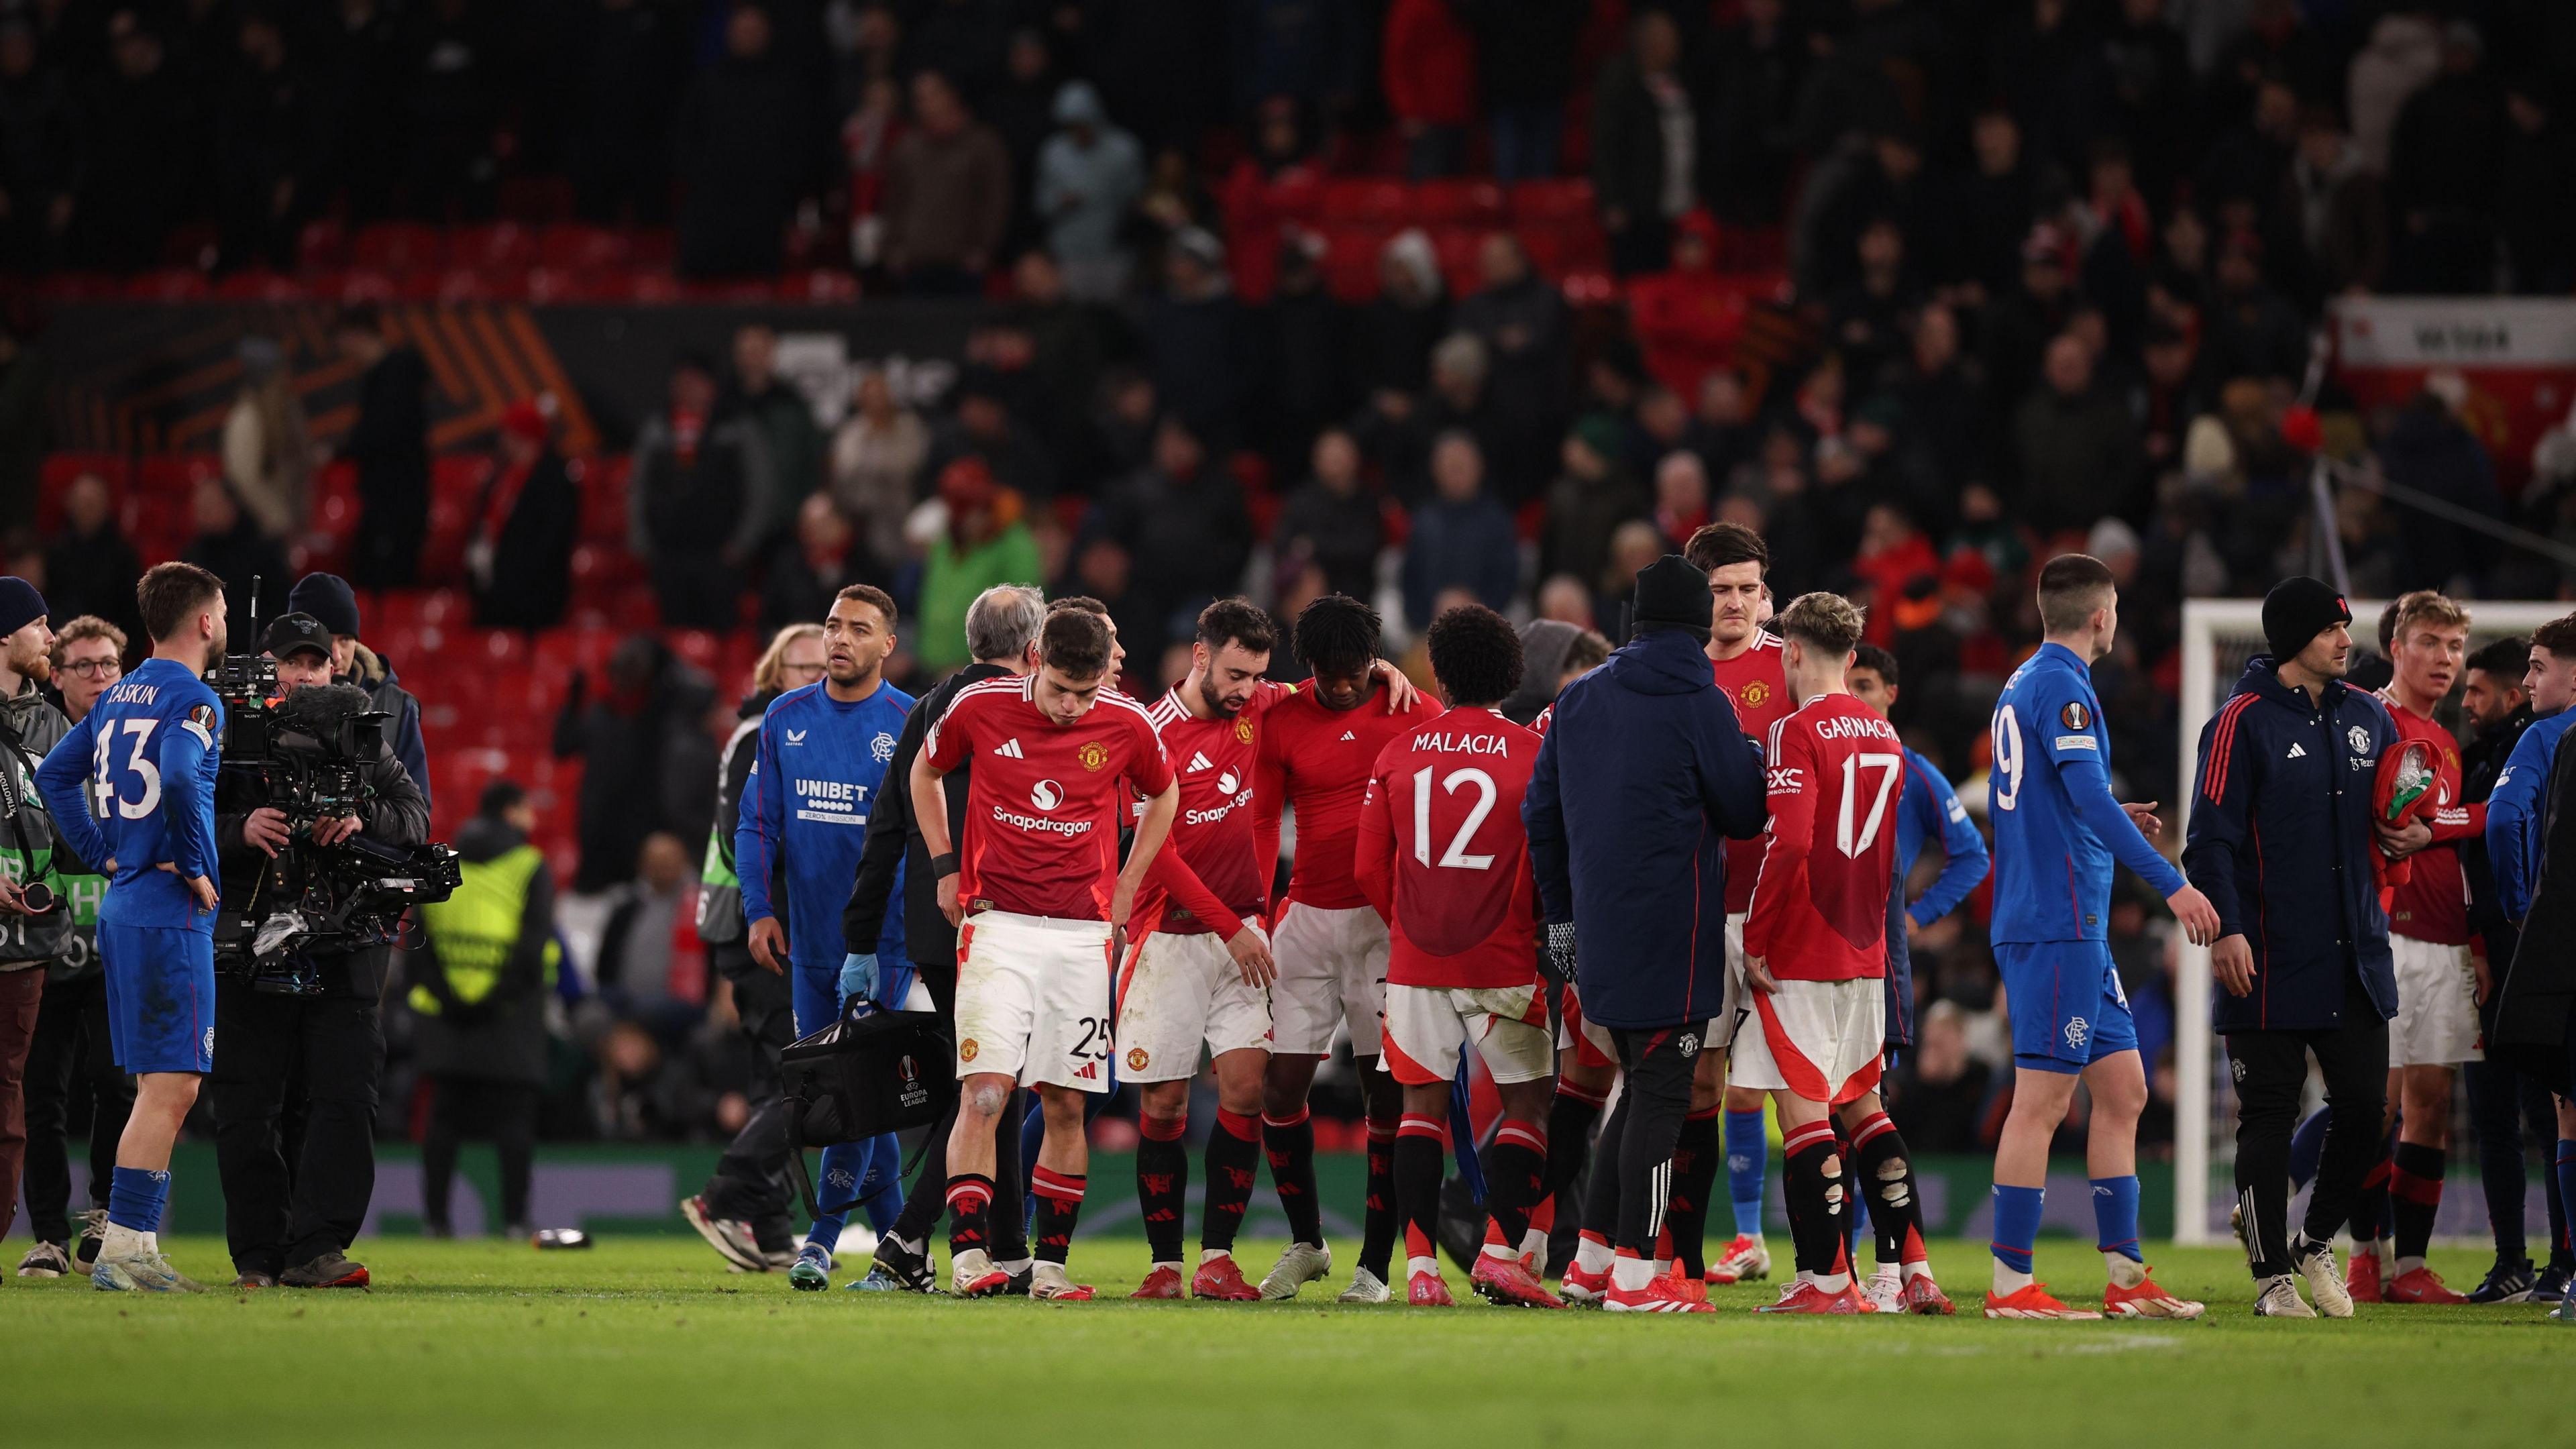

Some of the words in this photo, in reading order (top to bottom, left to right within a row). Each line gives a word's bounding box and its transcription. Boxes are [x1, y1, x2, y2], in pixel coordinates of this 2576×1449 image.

[107, 684, 160, 705] RASKIN
[1411, 732, 1507, 759] MALACIA
[93, 718, 162, 819] 43
[2359, 758, 2375, 767] Tezo
[795, 779, 868, 802] UNIBET
[805, 812, 826, 820] ZERO%
[828, 814, 856, 822] MISSION
[1413, 765, 1497, 870] 12
[1836, 752, 1900, 859] 17
[993, 806, 1092, 837] Snapdragon
[1069, 1017, 1108, 1060] 25
[900, 1089, 928, 1102] EUROPA
[904, 1095, 927, 1108] LEAGUE
